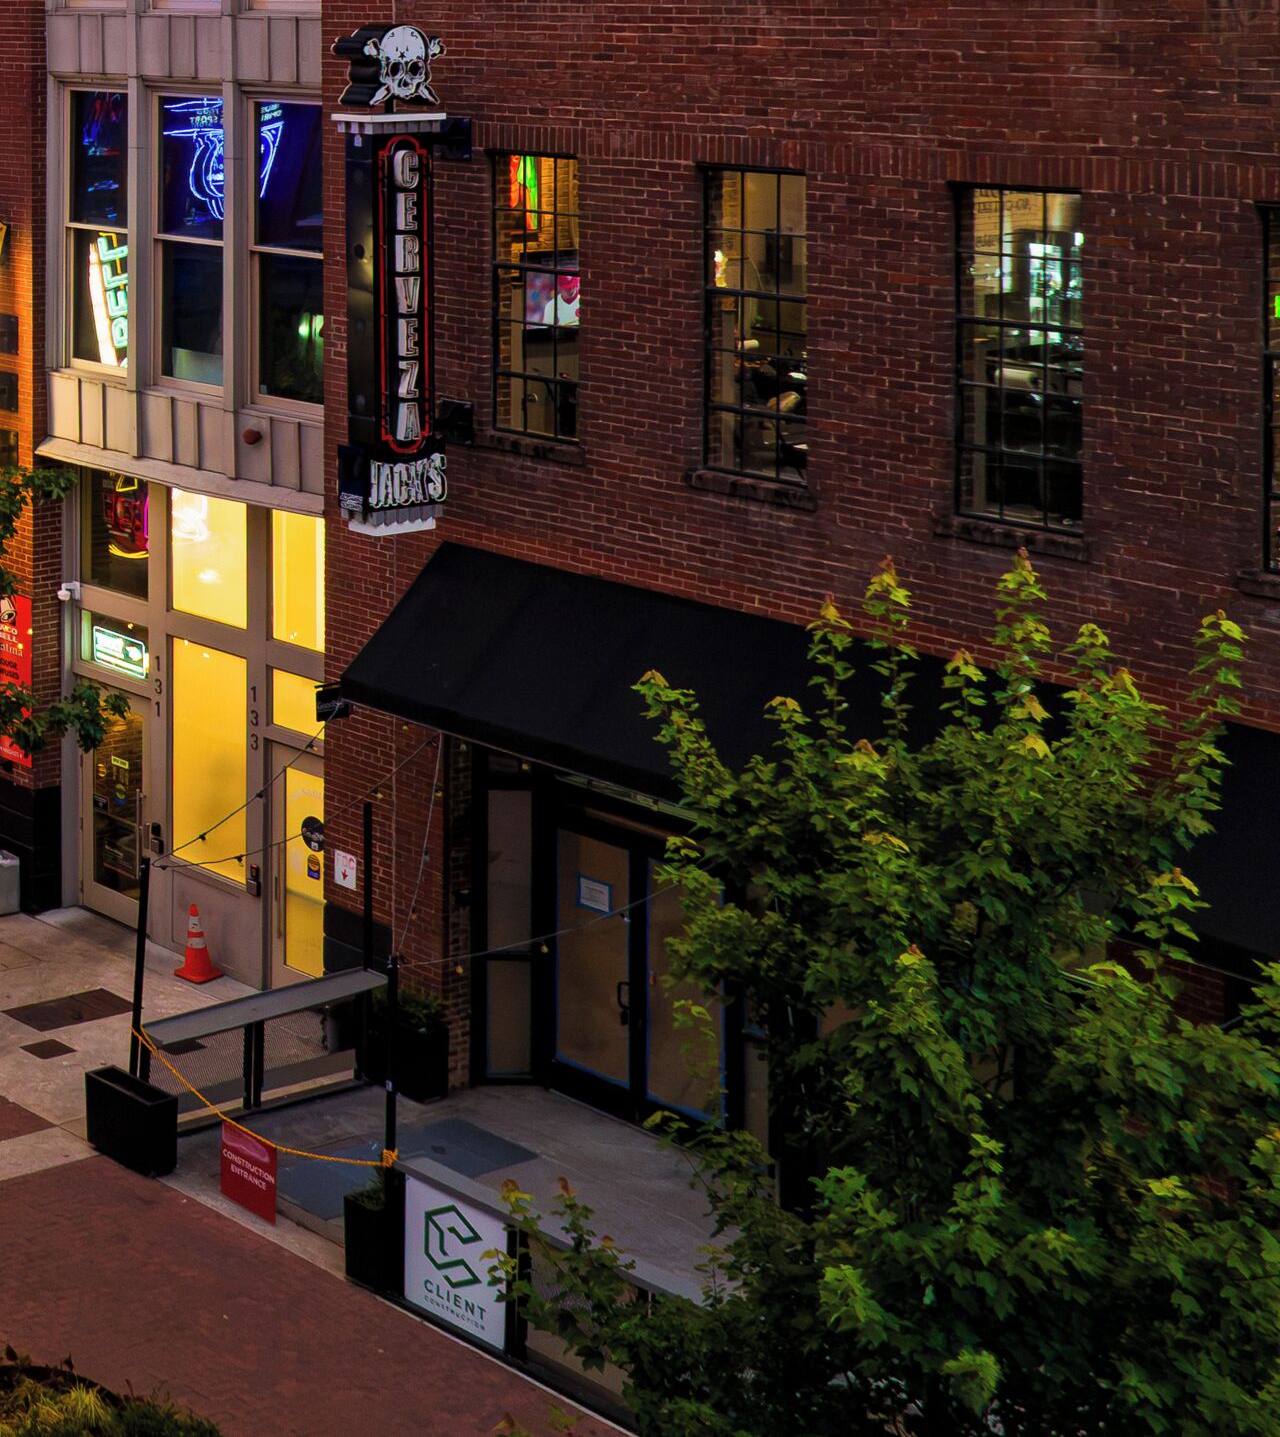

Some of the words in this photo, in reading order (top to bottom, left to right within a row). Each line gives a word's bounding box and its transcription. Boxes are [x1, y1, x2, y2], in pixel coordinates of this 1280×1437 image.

[393, 149, 420, 441] CERVEZA
[154, 655, 163, 717] 131
[249, 685, 259, 750] 133
[222, 1148, 275, 1184] CONSTRUCTION
[230, 1163, 266, 1191] ENTRANCE
[423, 1294, 486, 1331] CONSTRUCTION
[424, 1278, 487, 1321] CLIENT
